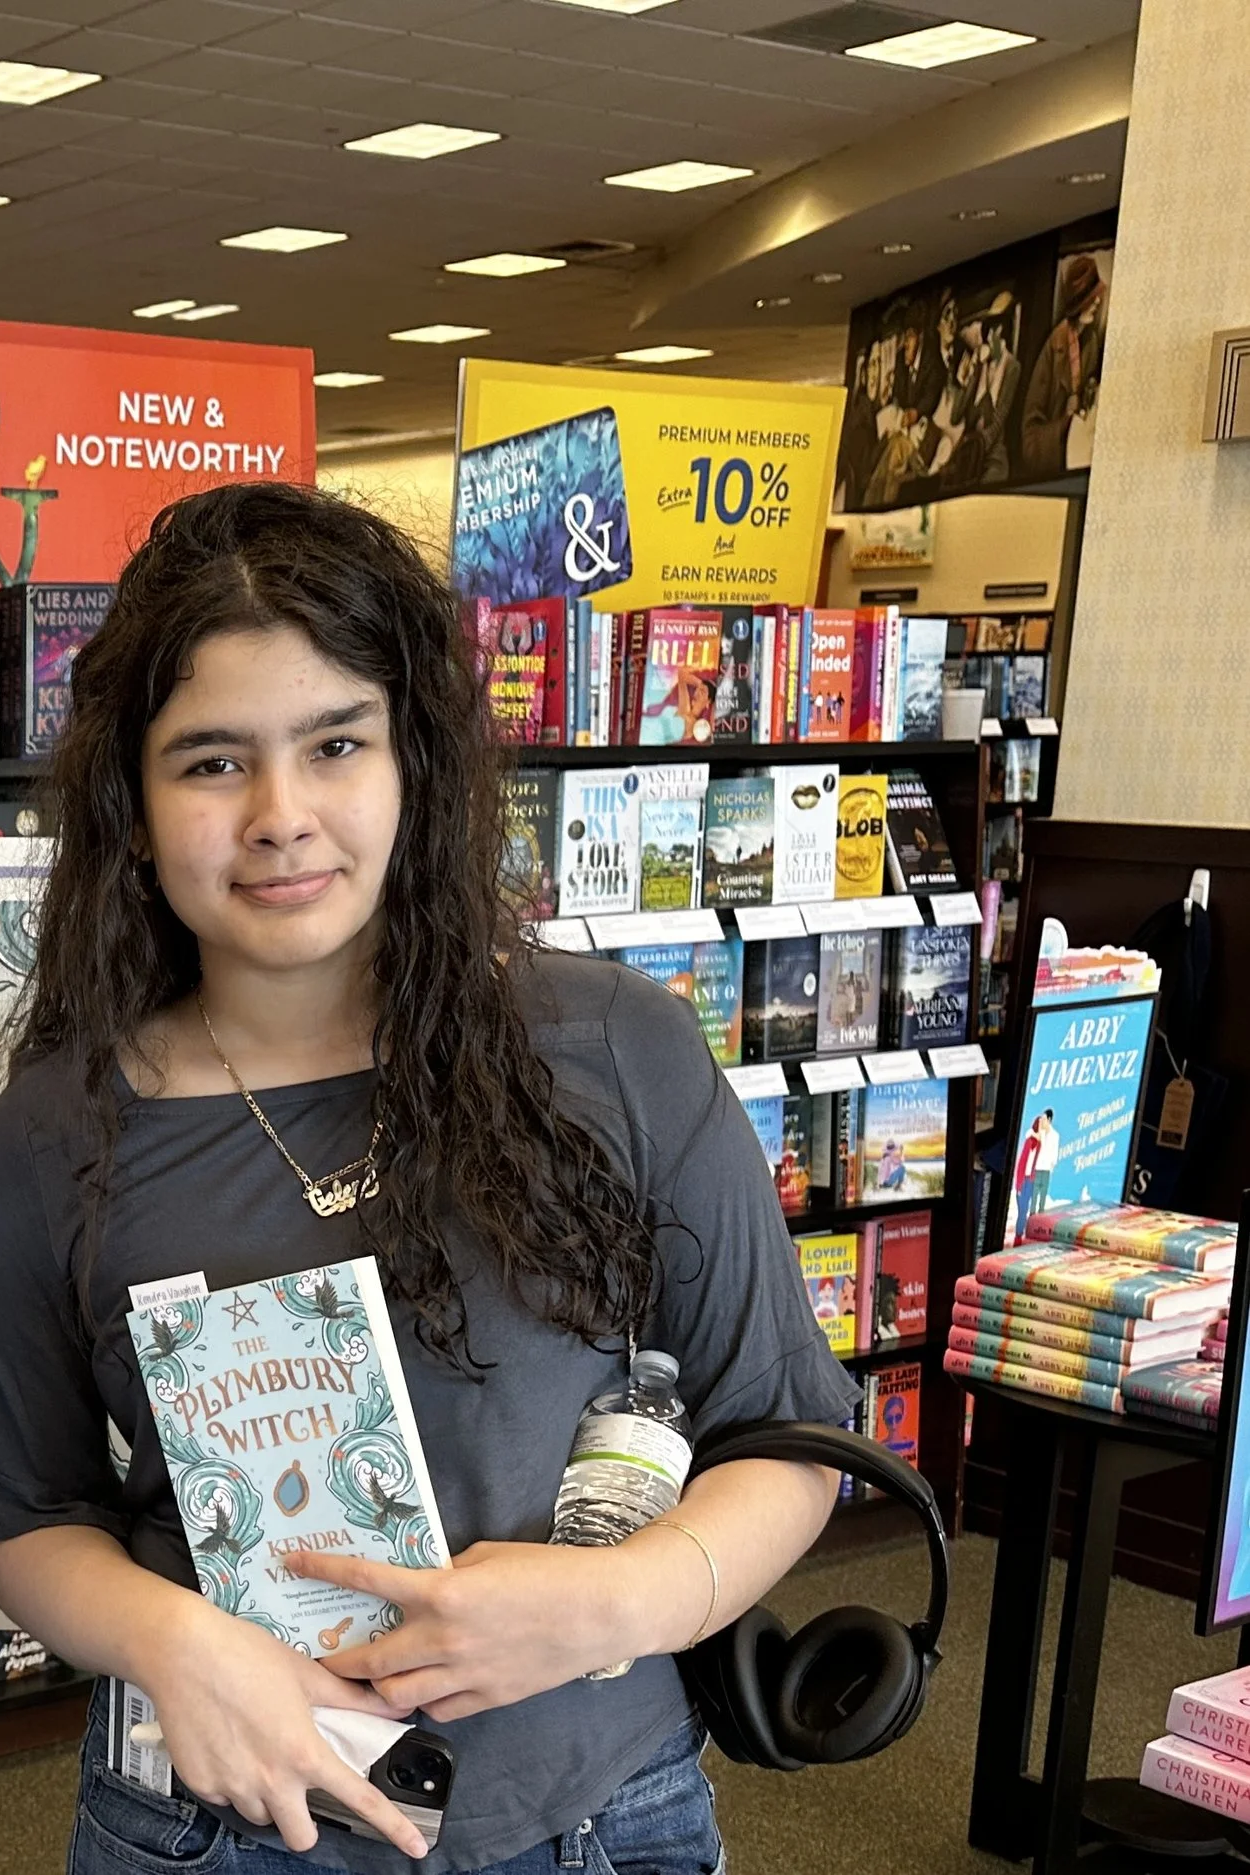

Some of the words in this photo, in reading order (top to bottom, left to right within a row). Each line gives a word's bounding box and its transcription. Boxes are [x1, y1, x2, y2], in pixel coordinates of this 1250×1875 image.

[119, 390, 196, 427] NEW
[204, 397, 225, 429] &
[659, 424, 731, 445] PREMIUM
[736, 431, 811, 450] MEMBERS
[55, 433, 286, 475] NOTEWORTHY
[460, 464, 538, 509] EMIUM
[657, 486, 692, 507] Extra
[456, 491, 541, 534] MBERSHIP
[750, 507, 791, 528] OFF
[713, 533, 736, 552] And
[661, 564, 702, 582] EARN
[706, 567, 778, 585] REWARDS
[37, 591, 70, 608] LIES
[73, 591, 109, 608] AND
[653, 623, 697, 635] KENNEDY
[698, 625, 718, 636] RYAN
[652, 639, 711, 667] REEL
[713, 791, 770, 805] NICHOLAS
[887, 782, 928, 796] ANIMAL
[581, 787, 627, 813] THIS
[886, 796, 933, 810] INSTINCT
[717, 806, 767, 822] SPARKS
[586, 815, 605, 840] IS
[577, 842, 626, 868] LOVE
[566, 869, 628, 897] STORY
[717, 874, 764, 888] Counting
[718, 887, 762, 901] Miracles
[820, 934, 836, 951] The
[837, 934, 865, 951] Echoes
[627, 951, 690, 964] REMARKABLY
[913, 998, 963, 1015] ADRIENNE
[917, 1011, 957, 1029] YOUNG
[1060, 1015, 1126, 1050] ABBY
[1030, 1049, 1139, 1095] JIMENEZ
[826, 1259, 853, 1273] LIARS
[136, 1290, 167, 1306] Kendra
[167, 1284, 201, 1300] Vaughan
[903, 1281, 924, 1297] skin
[232, 1336, 270, 1356] THE
[174, 1357, 357, 1434] PLYMBURY
[207, 1403, 338, 1455] WITCH
[266, 1526, 354, 1558] KENDRA
[1165, 1776, 1238, 1812] LAUREN
